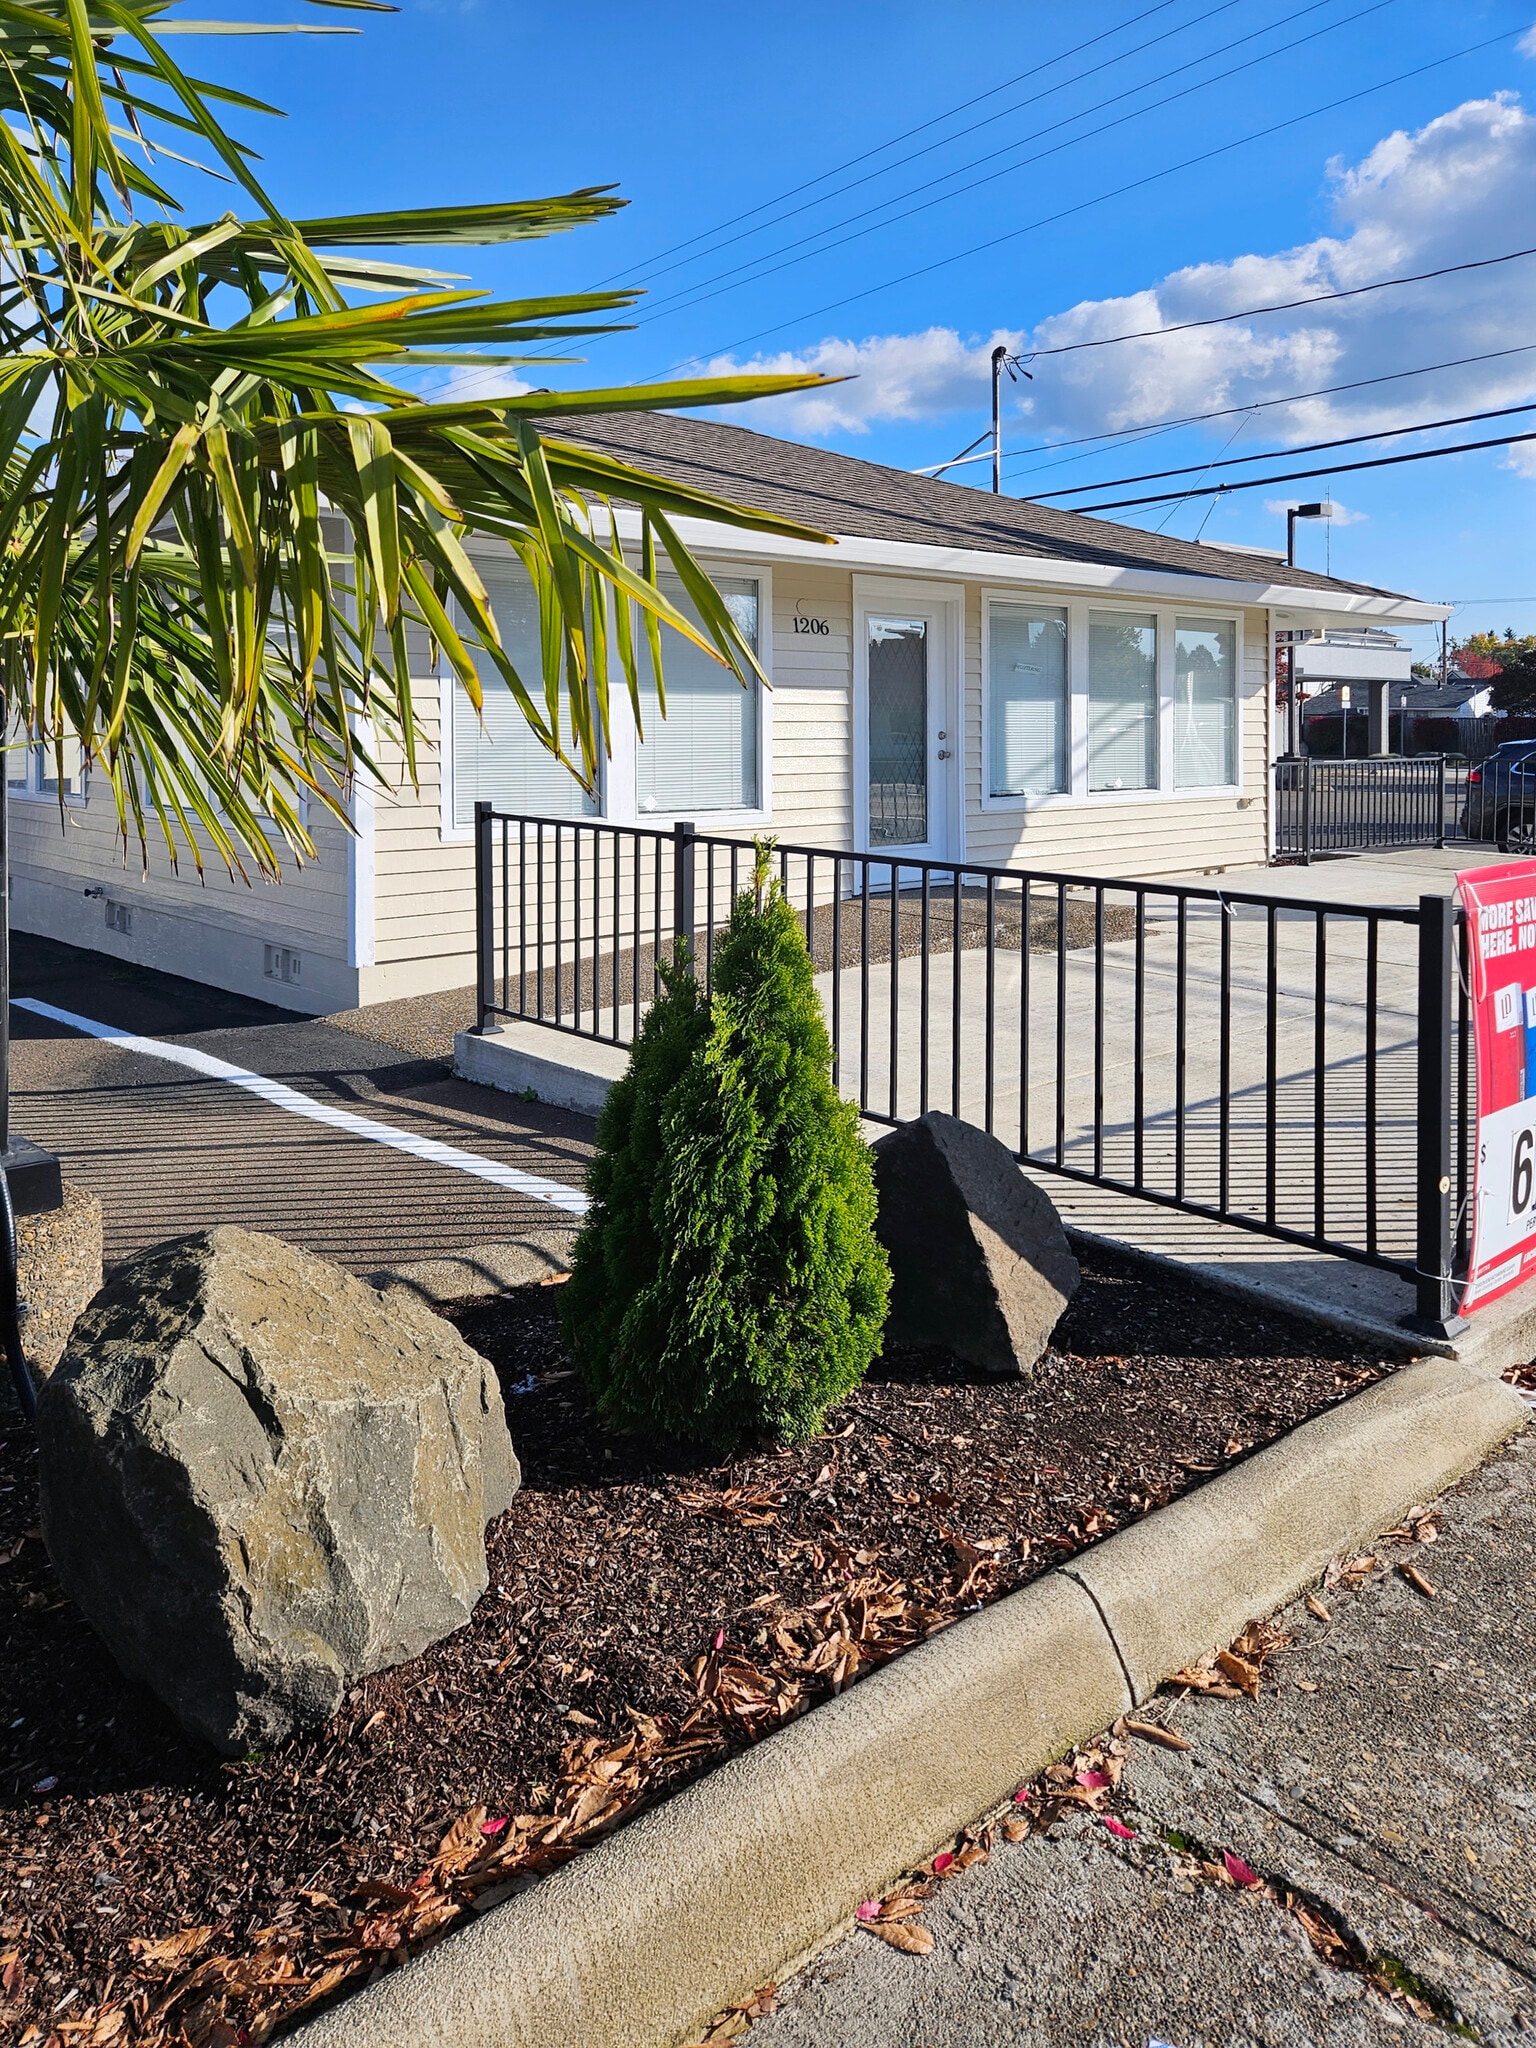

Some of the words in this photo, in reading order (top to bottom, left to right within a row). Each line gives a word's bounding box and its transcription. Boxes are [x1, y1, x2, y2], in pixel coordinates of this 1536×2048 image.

[792, 616, 830, 636] 1206
[1479, 901, 1514, 932] MORE
[1480, 928, 1517, 959] HERE.
[1518, 923, 1536, 951] NO
[1480, 1141, 1488, 1167] $
